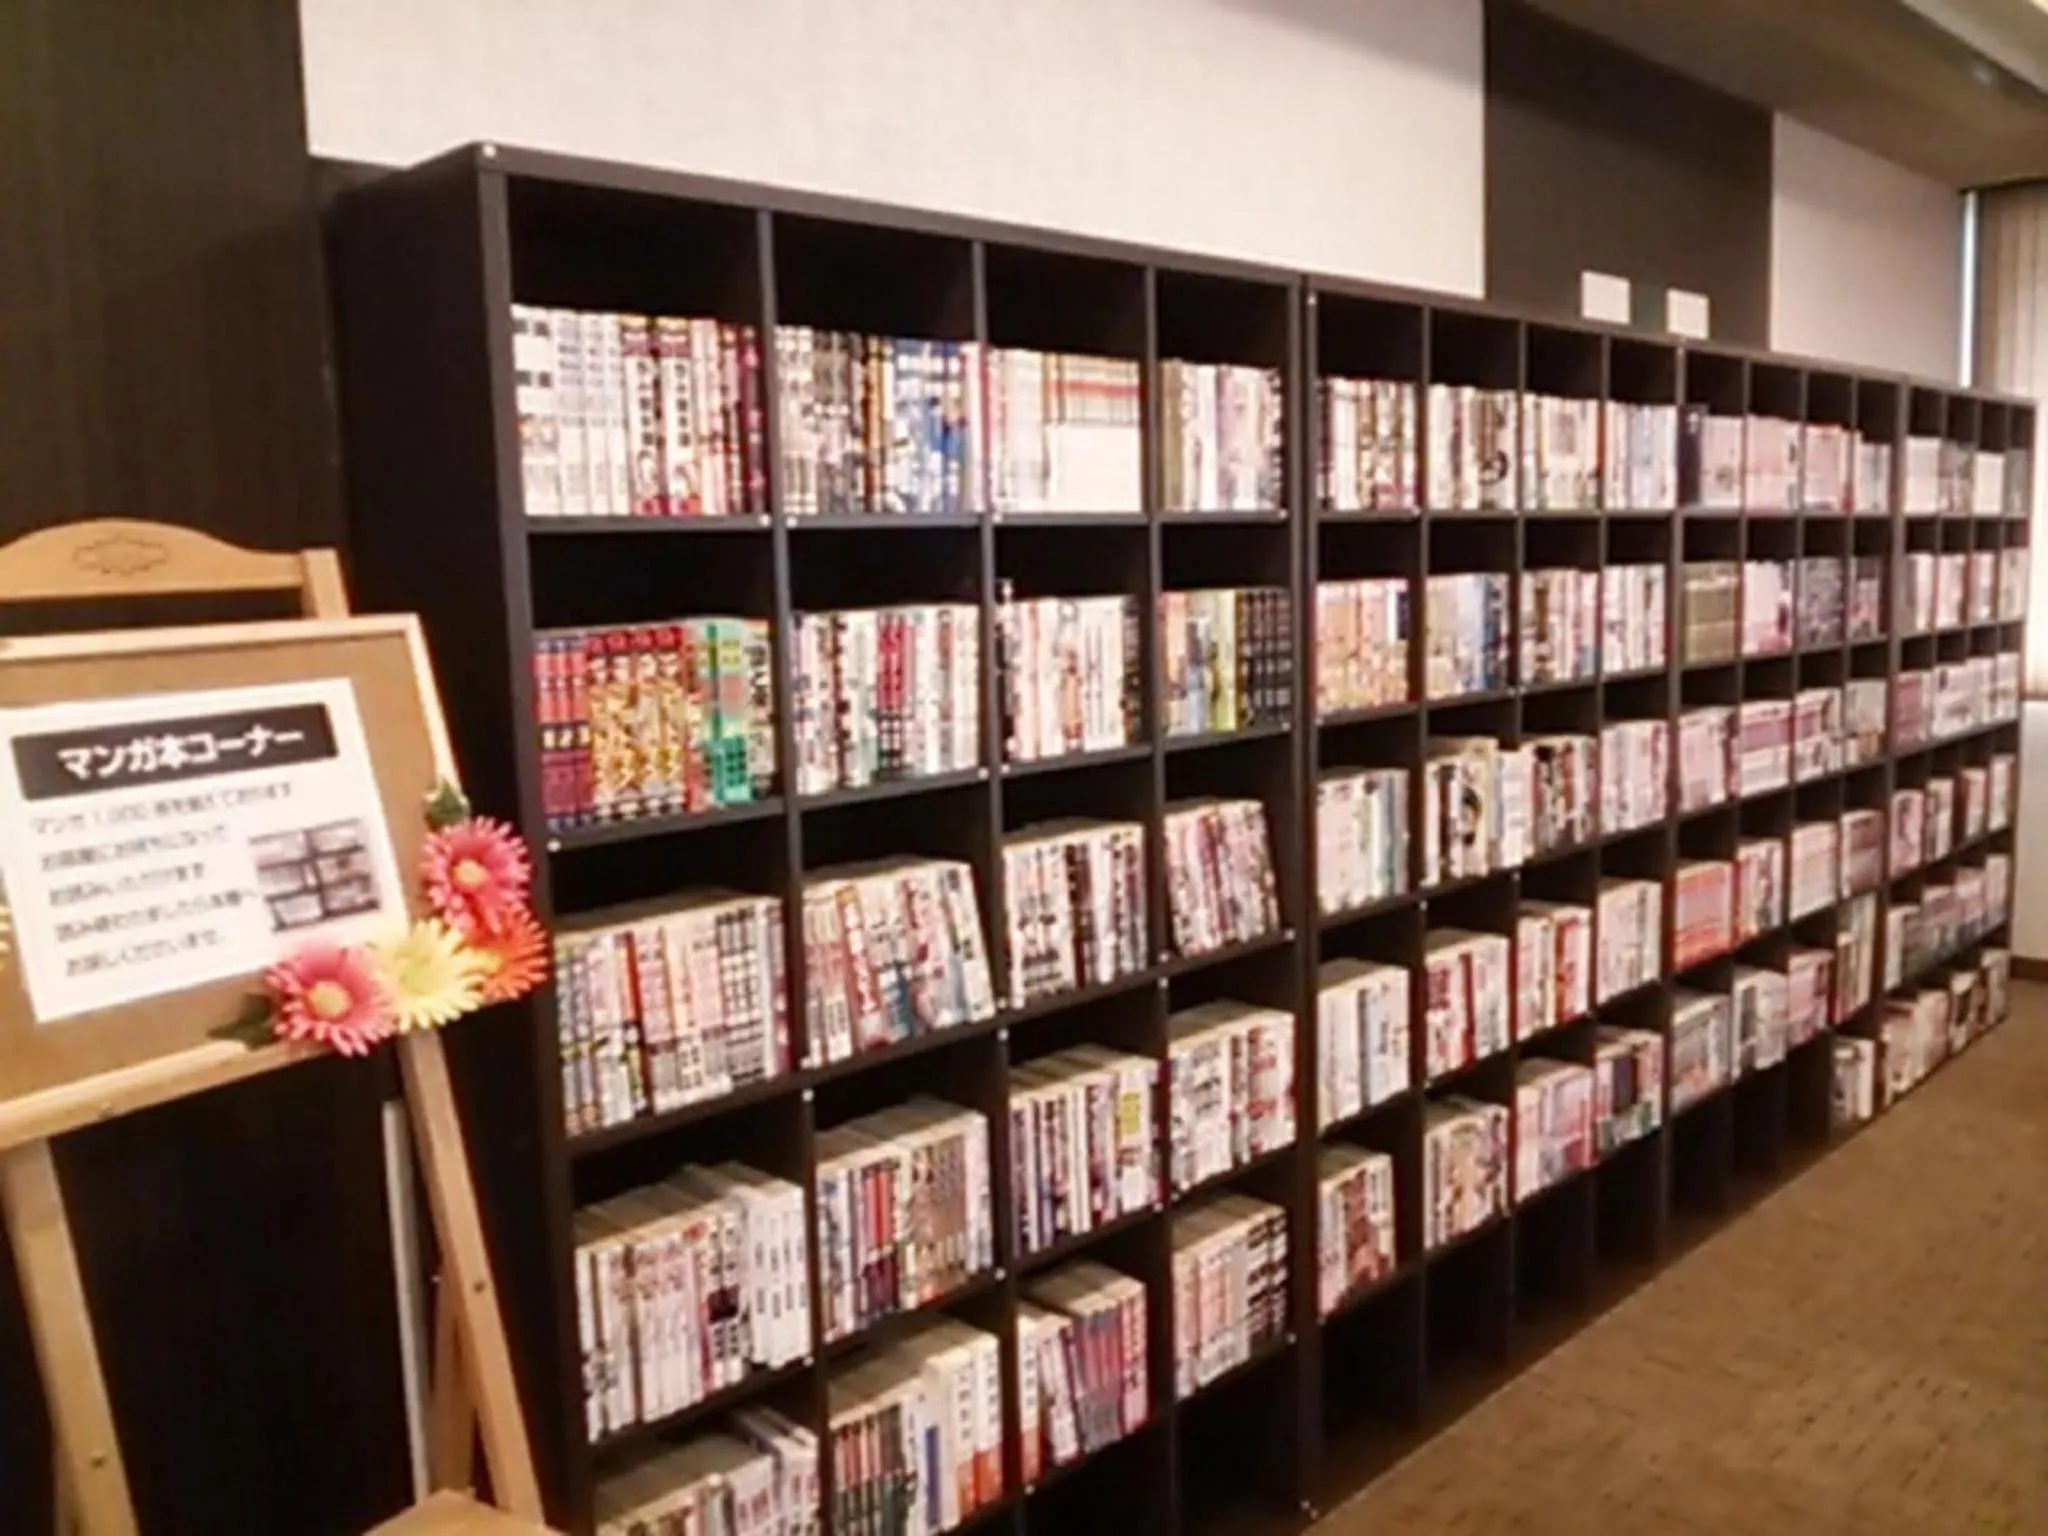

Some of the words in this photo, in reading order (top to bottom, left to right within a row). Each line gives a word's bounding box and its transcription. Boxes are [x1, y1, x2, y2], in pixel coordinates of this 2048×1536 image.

[57, 724, 304, 780] マンガ本コーナー
